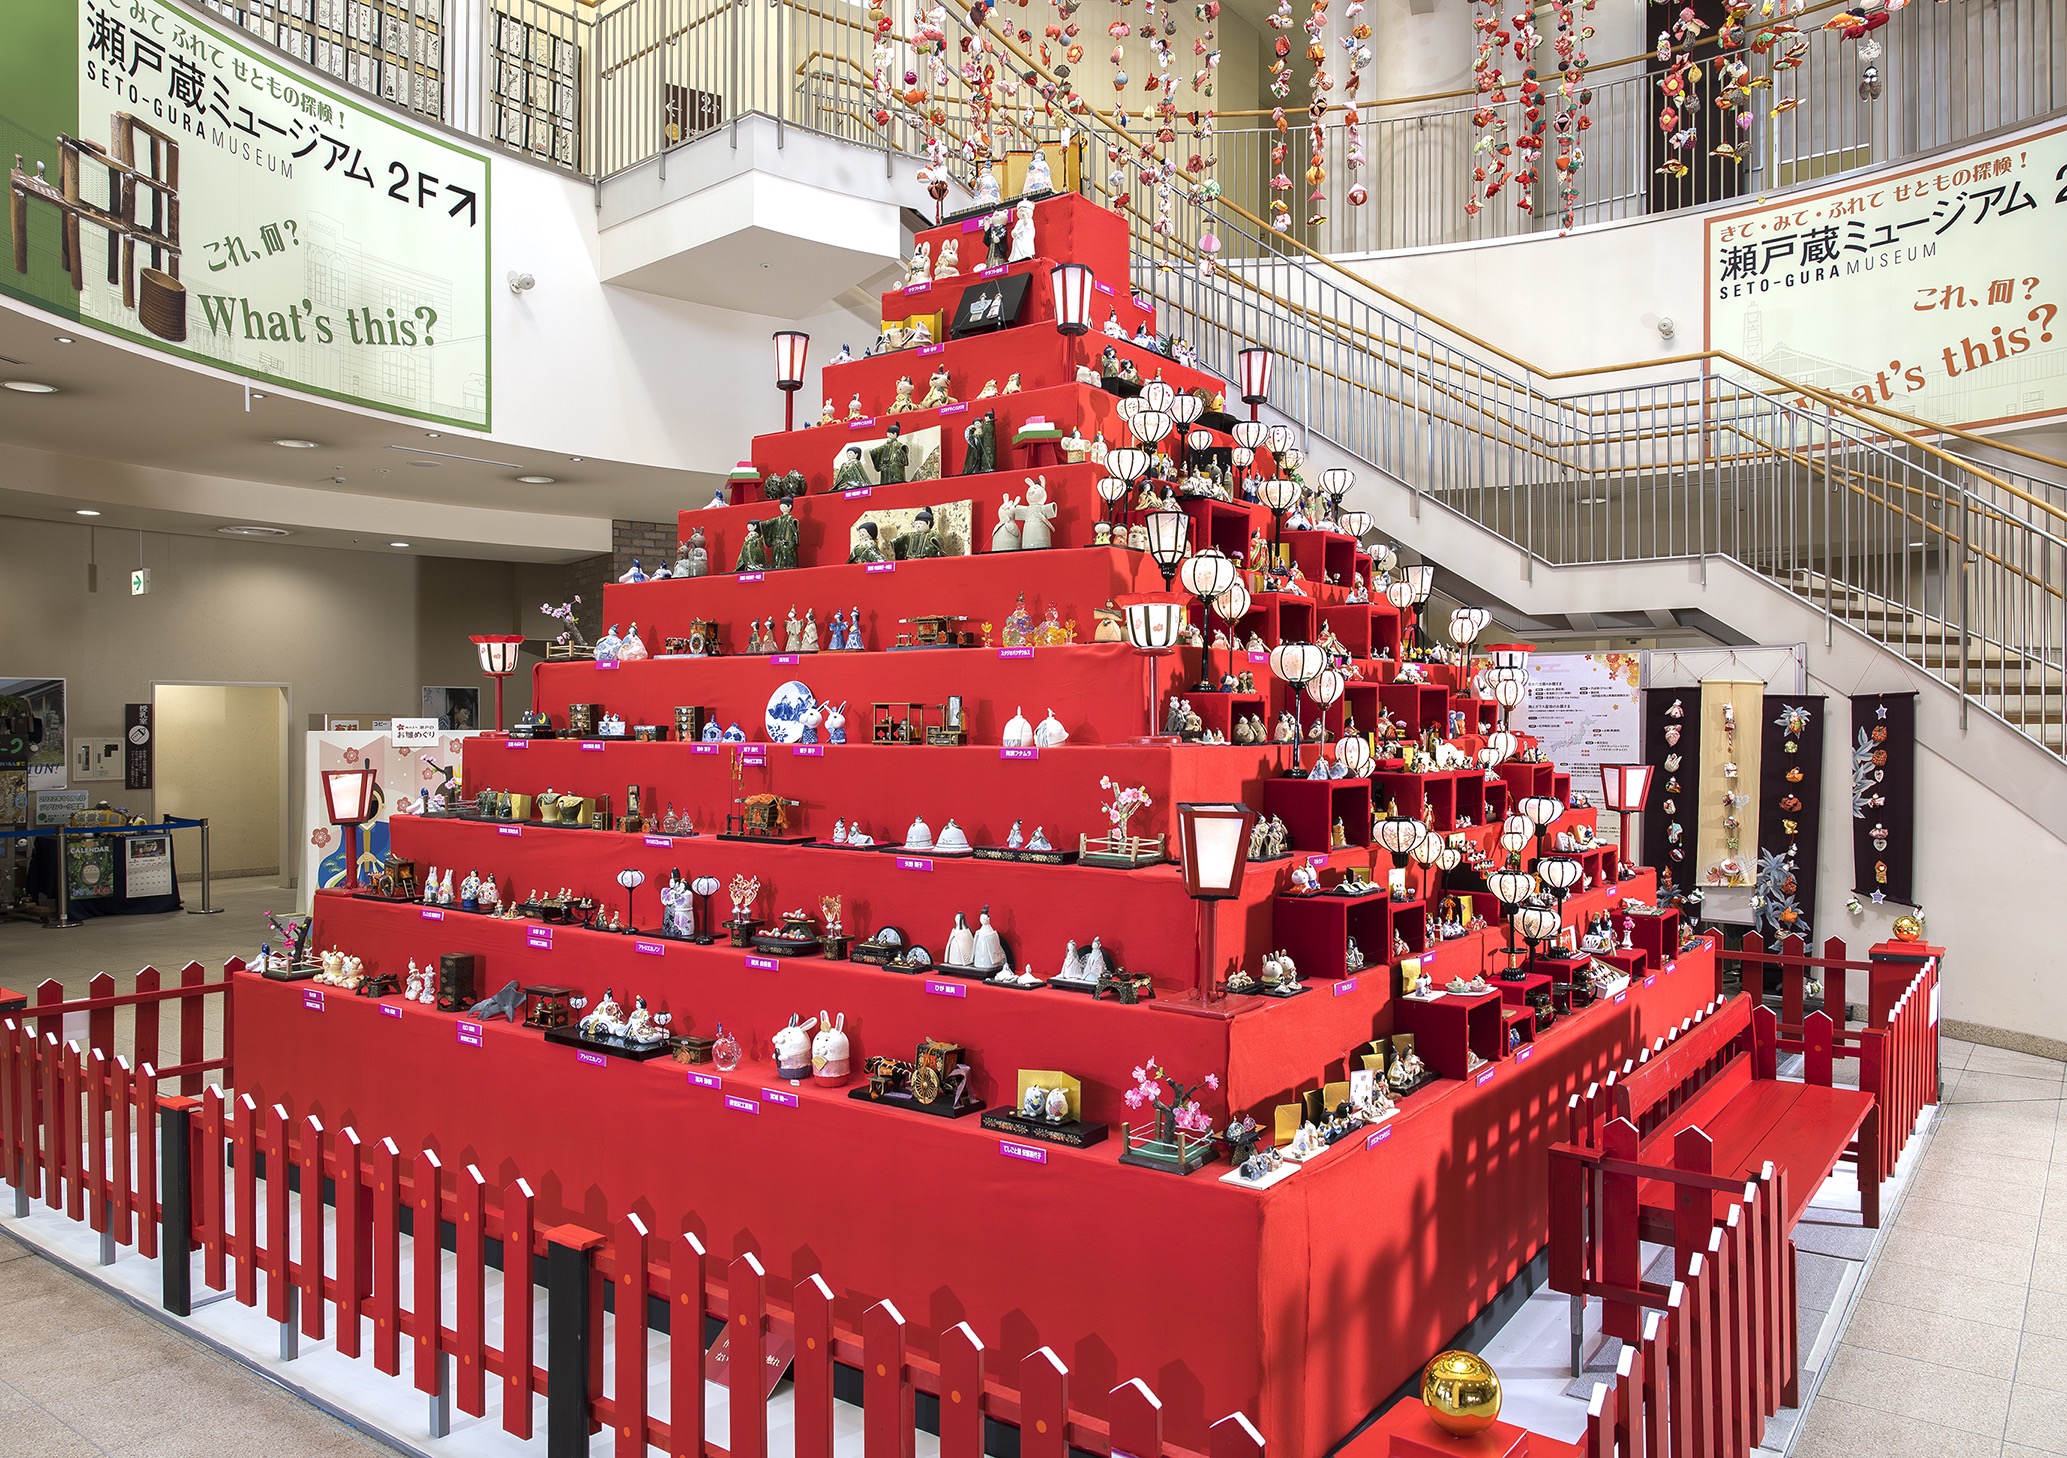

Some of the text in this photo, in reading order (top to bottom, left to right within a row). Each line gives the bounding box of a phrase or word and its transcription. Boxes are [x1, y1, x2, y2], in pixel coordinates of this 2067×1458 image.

[130, 0, 345, 130] みて ふれて せともの探検！
[87, 0, 376, 190] 瀬戸蔵ミュージアム
[387, 160, 440, 210] 2F
[1893, 151, 2028, 203] せともの探検！
[202, 218, 300, 273] これ、何？
[1719, 180, 2038, 282] 瀬戸蔵ミュージアム
[198, 293, 438, 349] What's this?
[1913, 277, 2040, 312] これ、何？
[1941, 303, 2058, 378] this?
[70, 845, 110, 854] CALENDAR
